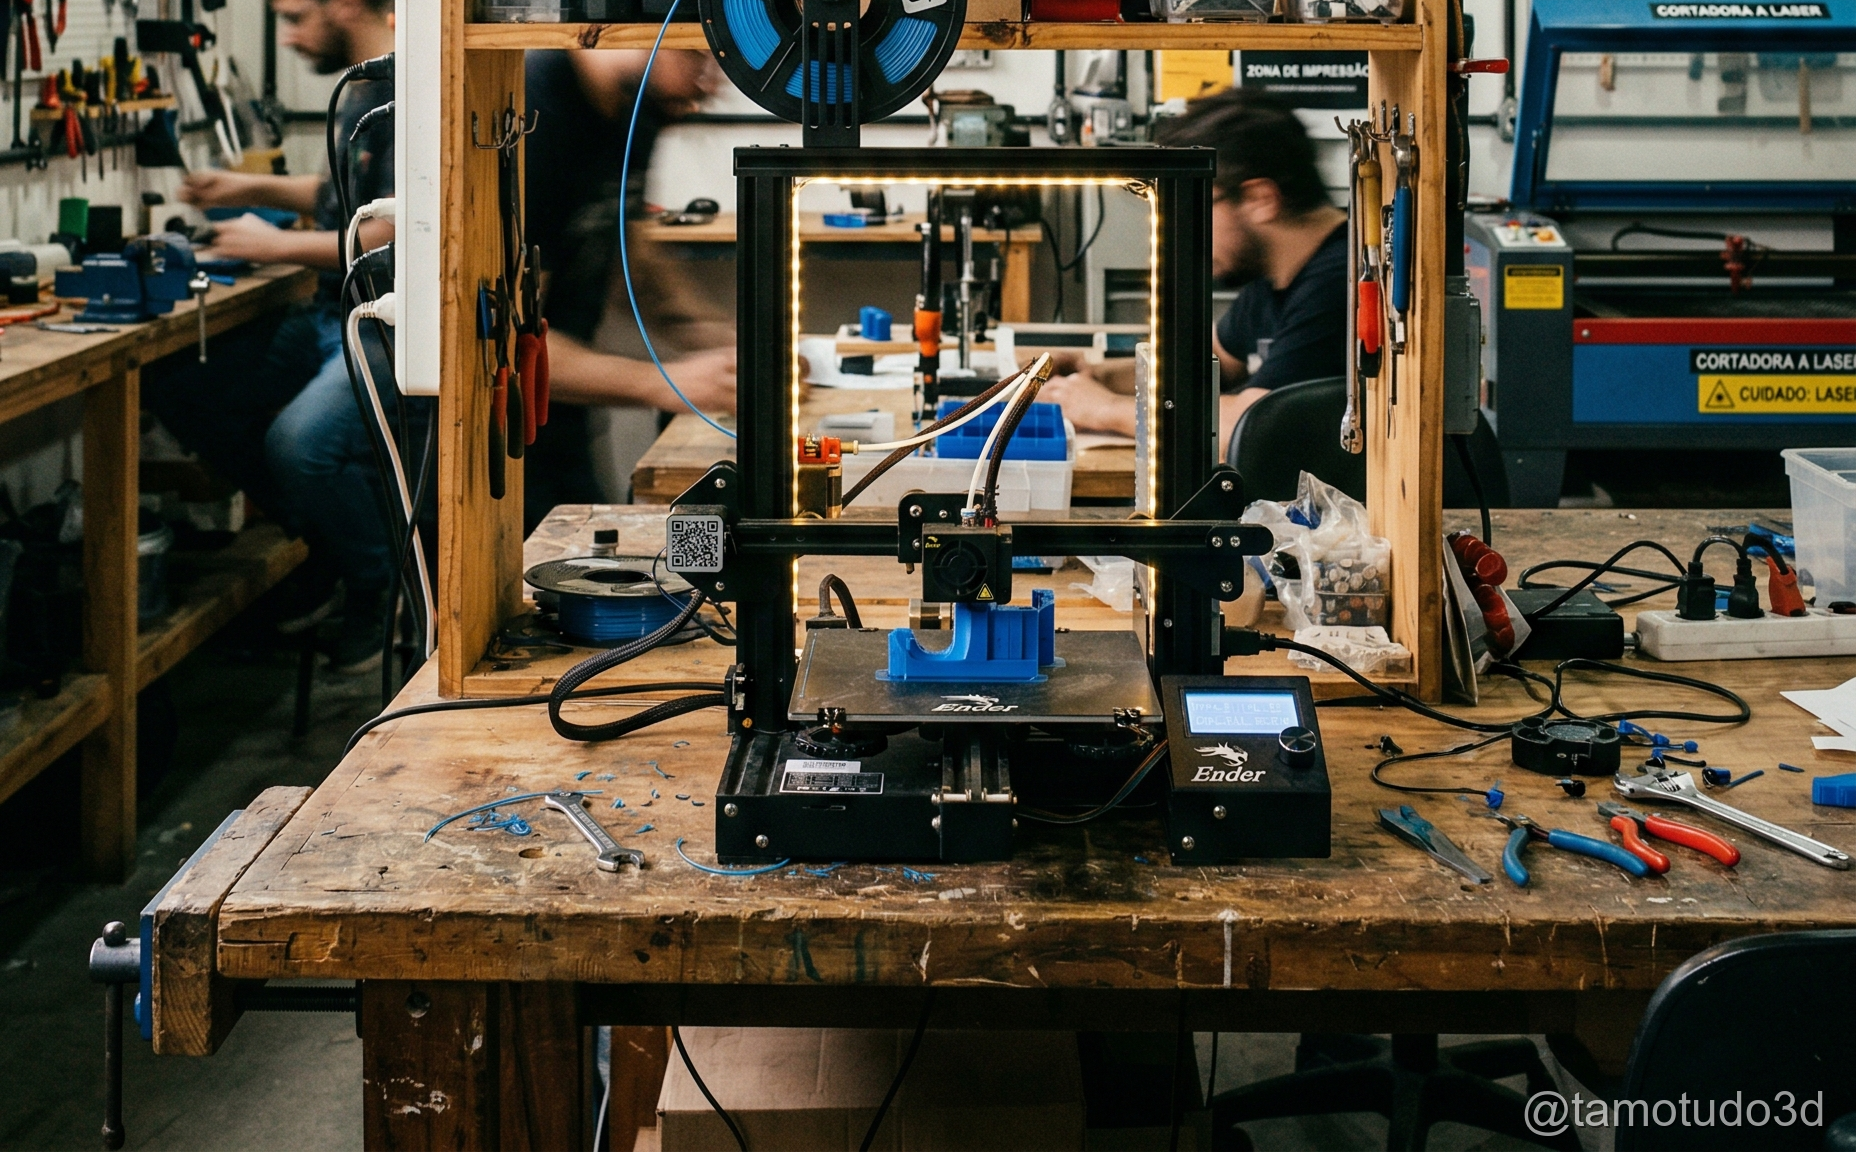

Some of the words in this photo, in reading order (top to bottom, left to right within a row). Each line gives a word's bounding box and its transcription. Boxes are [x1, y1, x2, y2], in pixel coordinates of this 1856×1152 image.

[1656, 4, 1754, 17] CORTADORA
[1755, 5, 1769, 17] A
[1769, 4, 1823, 17] LASER
[1246, 64, 1281, 78] ZONA
[1282, 64, 1300, 78] DE
[1695, 352, 1795, 370] CORTADORA
[1798, 352, 1810, 370] A
[1813, 352, 1856, 370] LASE
[1739, 386, 1811, 402] CUIDADO:
[1815, 386, 1856, 403] LASE
[931, 703, 1019, 712] Ender
[1190, 766, 1267, 783] Ender
